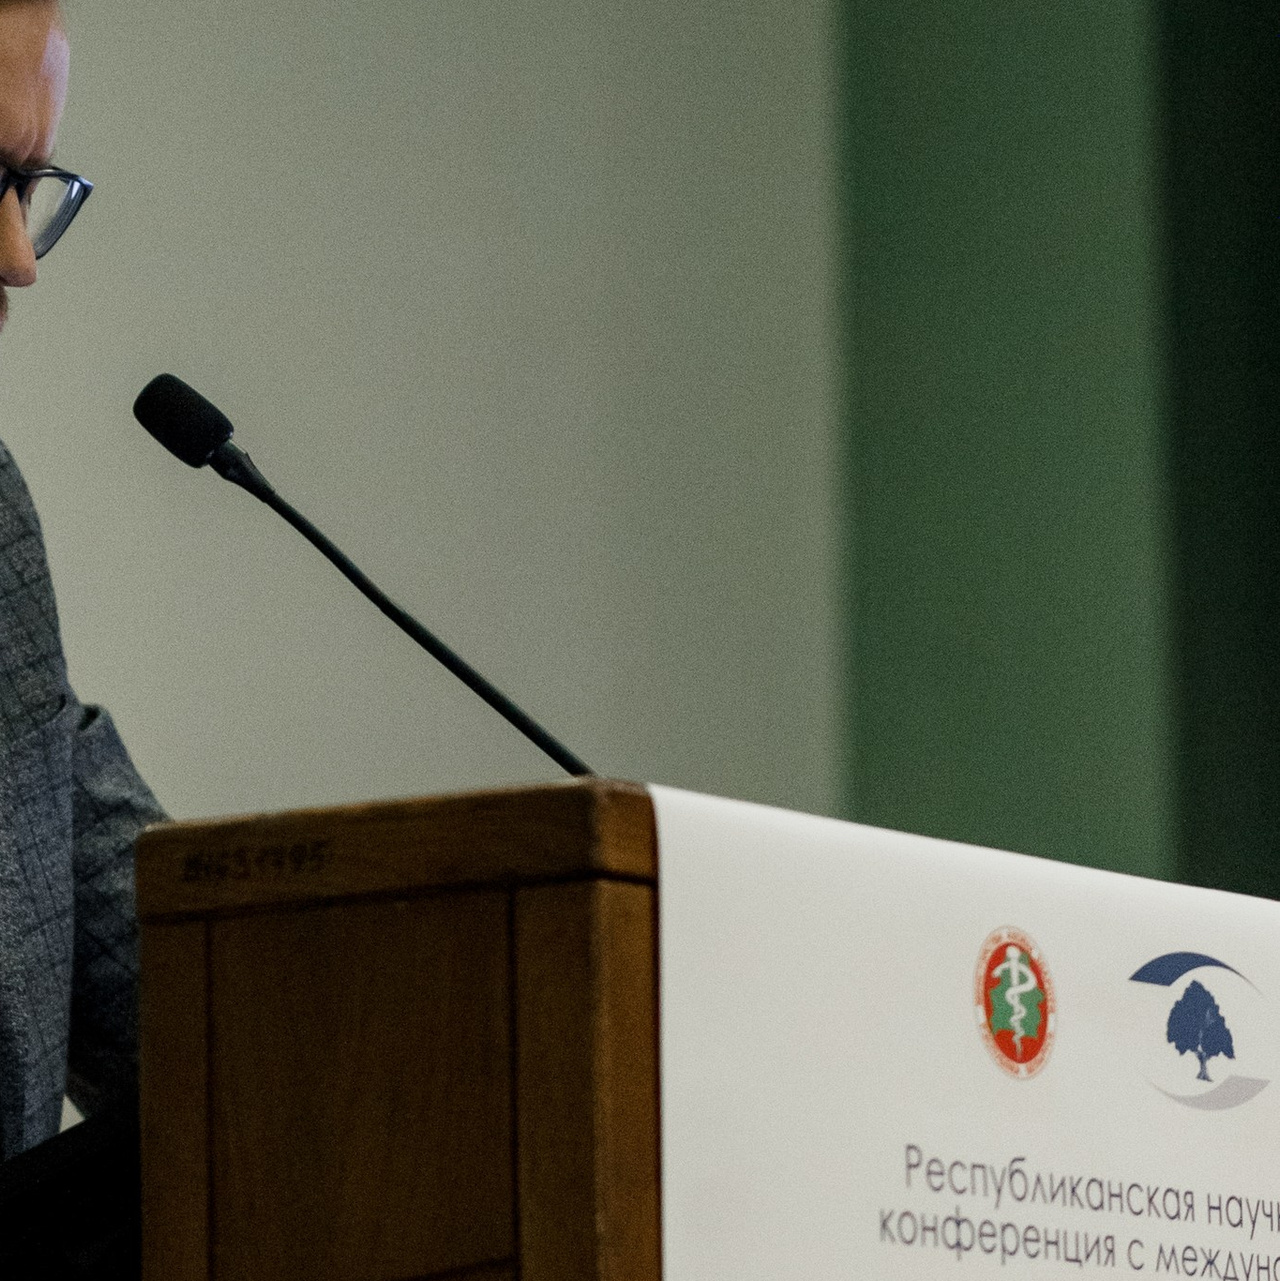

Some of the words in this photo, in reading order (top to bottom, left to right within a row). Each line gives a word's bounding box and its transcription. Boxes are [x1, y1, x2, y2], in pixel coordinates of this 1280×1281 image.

[904, 1143, 1196, 1222] Республиканская
[1207, 1192, 1280, 1241] науч
[879, 1204, 1116, 1267] конференция
[1126, 1239, 1145, 1271] с
